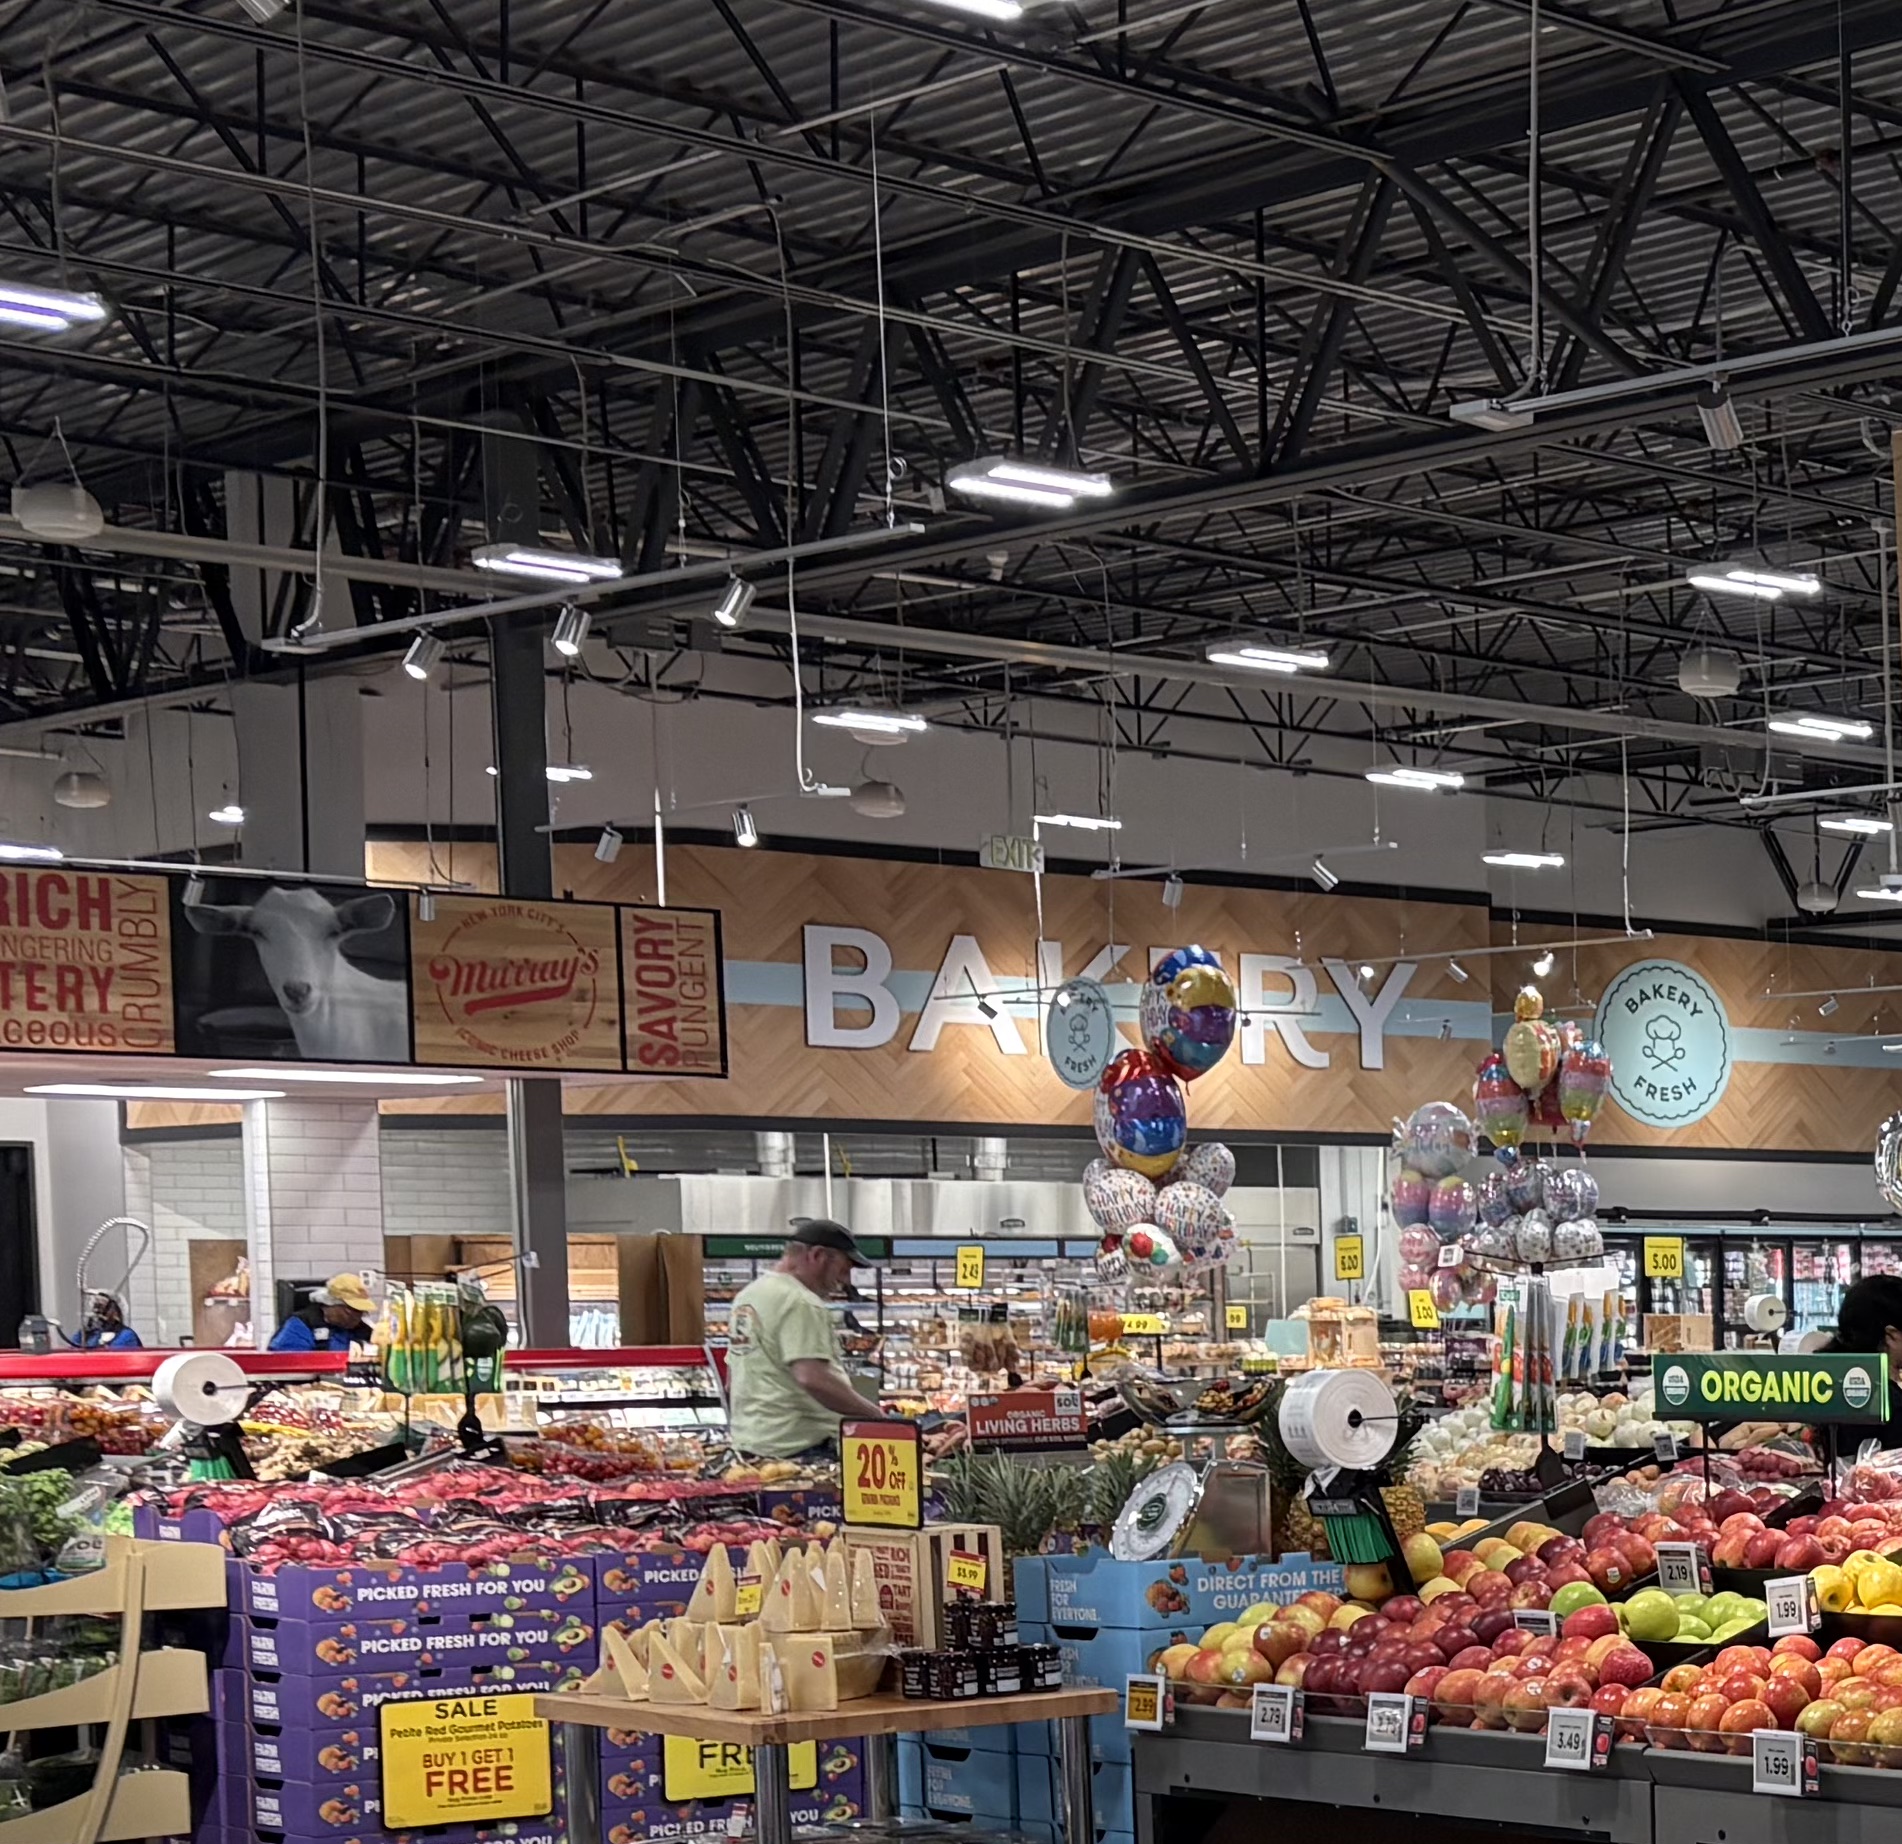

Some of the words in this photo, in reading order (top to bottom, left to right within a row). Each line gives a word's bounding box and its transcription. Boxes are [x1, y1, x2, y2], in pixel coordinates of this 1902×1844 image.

[462, 908, 490, 930] NEW
[491, 904, 526, 920] YORK
[118, 877, 164, 1050] CRUMBLY
[429, 948, 599, 1005] Murray's
[633, 914, 681, 1067] SAVORY
[675, 917, 711, 1068] PUNGENT
[802, 922, 1418, 1070] BAKRY
[1624, 983, 1704, 1018] BAKERY
[500, 1047, 549, 1061] CHEESE
[551, 1029, 580, 1055] SHOP
[1064, 1056, 1097, 1074] FRESH
[1632, 1075, 1698, 1102] FRESH
[1652, 1253, 1677, 1271] 5.00
[1701, 1369, 1834, 1403] ORGANIC
[976, 1419, 1028, 1434] LIVING
[1031, 1417, 1080, 1433] HERBS
[857, 1443, 886, 1490] 20
[889, 1471, 907, 1491] OFF
[645, 1570, 699, 1584] PICKED
[1051, 1578, 1078, 1594] FRESH
[1197, 1575, 1255, 1593] DIRECT
[1260, 1571, 1307, 1588] FROM
[1311, 1568, 1343, 1585] THE
[357, 1586, 418, 1601] PICKED
[423, 1584, 471, 1597] FRESH
[475, 1580, 507, 1595] FOR
[511, 1578, 546, 1593] YOU
[1776, 1601, 1796, 1619] 1.99
[360, 1637, 421, 1654] PICKED
[426, 1635, 474, 1650] FRESH
[478, 1632, 510, 1647] FOR
[514, 1630, 549, 1645] YOU
[435, 1699, 498, 1719] SALE
[390, 1728, 422, 1739] Petite
[425, 1726, 446, 1736] Red
[449, 1723, 496, 1734] Gourmet
[498, 1720, 543, 1730] Potatoes
[1557, 1726, 1581, 1749] 3.49
[423, 1752, 456, 1768] BUY
[461, 1752, 467, 1765] 1
[472, 1749, 503, 1765] GET
[508, 1748, 514, 1761] 1
[1765, 1756, 1790, 1776] 1.99
[425, 1765, 514, 1797] FREE
[790, 1808, 819, 1823] YOU
